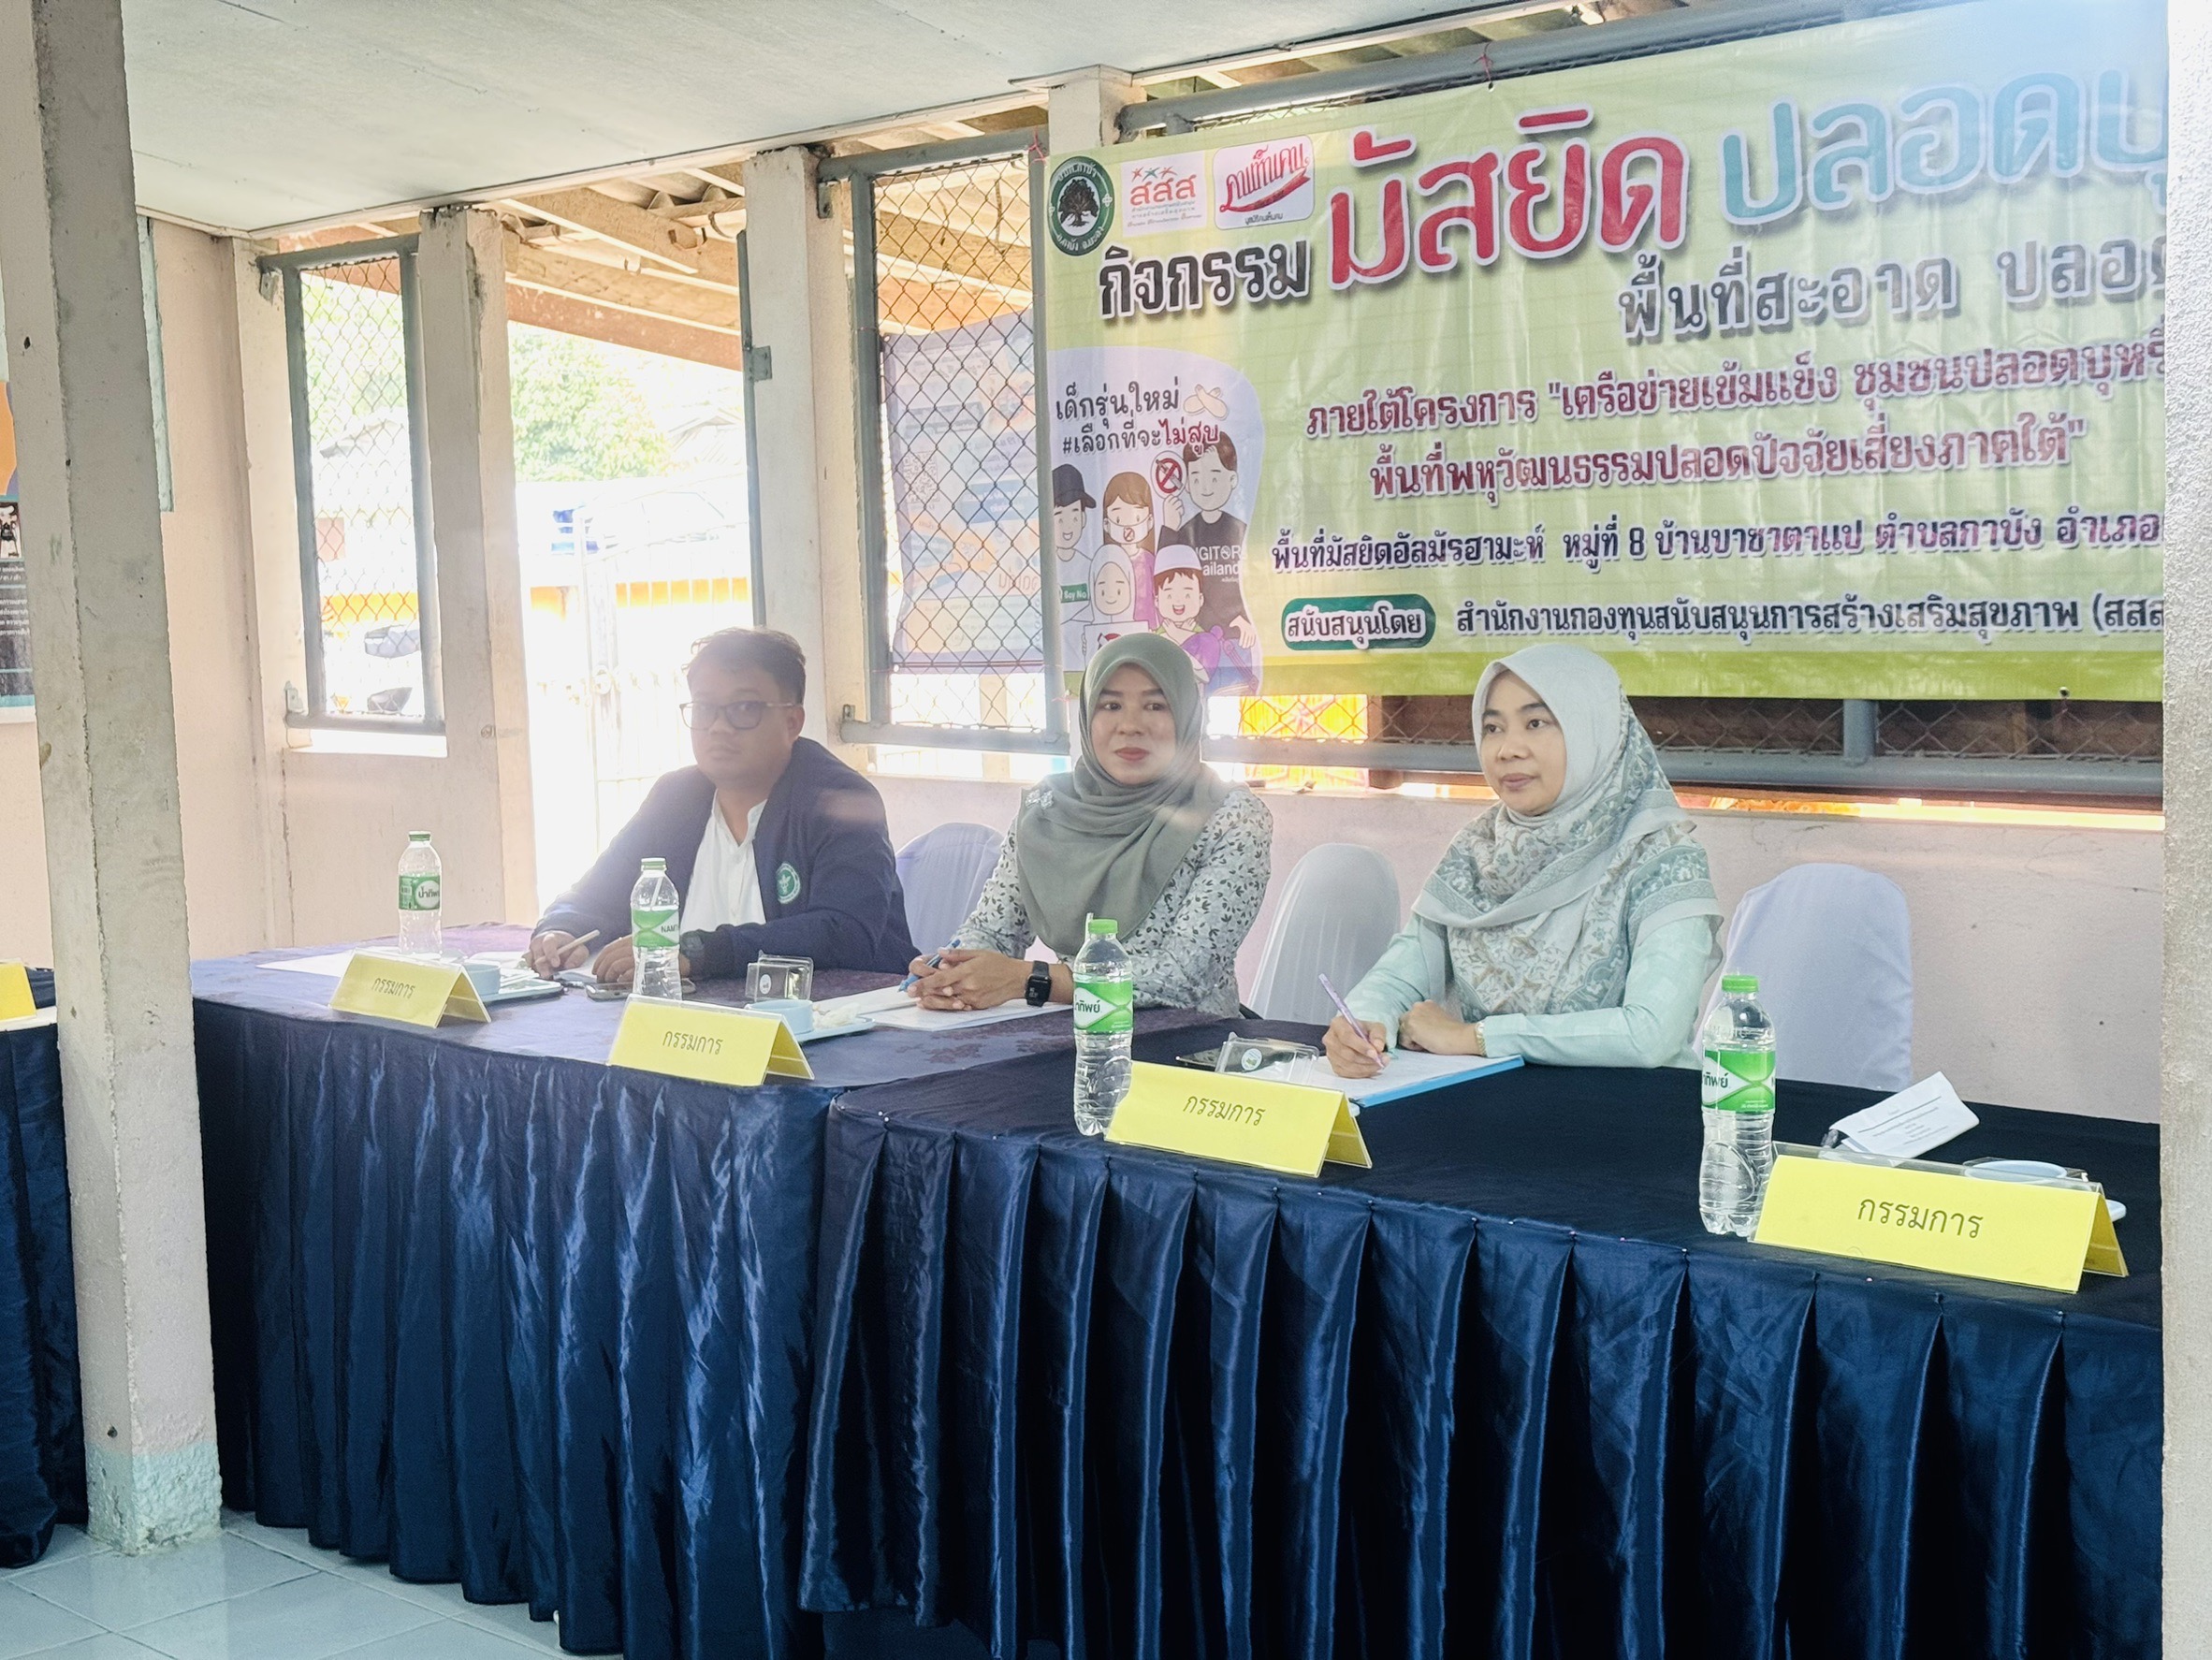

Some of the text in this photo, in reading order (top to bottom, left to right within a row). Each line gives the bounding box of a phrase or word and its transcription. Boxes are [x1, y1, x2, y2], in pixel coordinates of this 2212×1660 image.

[1099, 240, 1307, 315] กิจกรรม
[1331, 109, 1684, 284] มัสยิด
[1129, 174, 1197, 206] สสส
[1620, 245, 1953, 333] พื้นที่สะอาด
[1055, 376, 1180, 430] เด็กรุ่นใหม่
[1306, 385, 1536, 435] ภายใต้โครงการ
[1548, 350, 1838, 417] "เครือข่ายเข้มแข็ง
[1062, 409, 1219, 456] #เลือกที่จะไม่สูบ
[1369, 411, 2084, 503] พื้นที่พหุวัฒนธรรมปลอดปัจจัยเสี่ยงภาคใต้"
[1563, 514, 1619, 569] หมู่ที่
[1628, 527, 1646, 557] 8
[1875, 507, 2043, 551] ตำบลกาบัง
[2057, 505, 2164, 545] อำเภอ
[1076, 589, 1087, 599] No
[1457, 592, 2079, 641] สำนักงานกองทุนสนับสนุนการสร้างเสริมสุขภาพ
[1287, 605, 1422, 645] สนับสนุนโดย
[371, 977, 416, 1000] กรรมการ
[662, 1030, 724, 1056] กรรมการ
[1182, 1095, 1267, 1127] กรรมการ
[1857, 1198, 1985, 1239] กรรมการ
